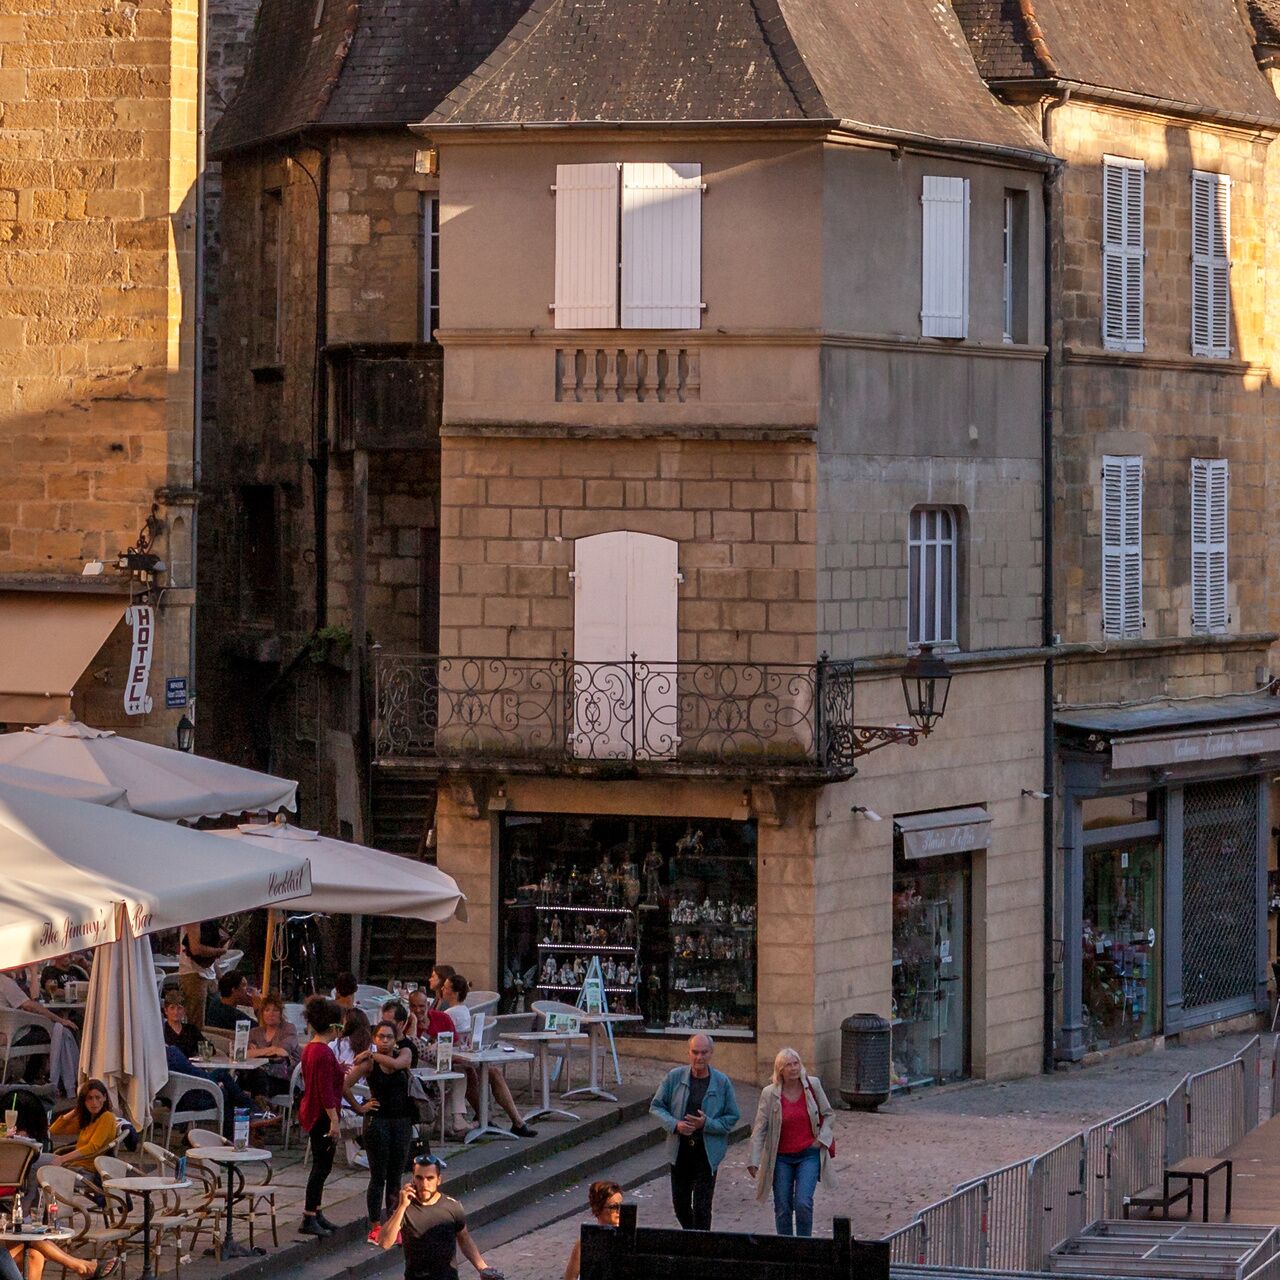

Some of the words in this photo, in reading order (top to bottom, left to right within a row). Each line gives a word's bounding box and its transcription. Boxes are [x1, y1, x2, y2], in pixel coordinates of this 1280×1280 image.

[129, 609, 150, 702] HOTEL
[39, 921, 59, 947] The
[61, 908, 107, 950] Jimmy's
[131, 903, 153, 933] Bar
